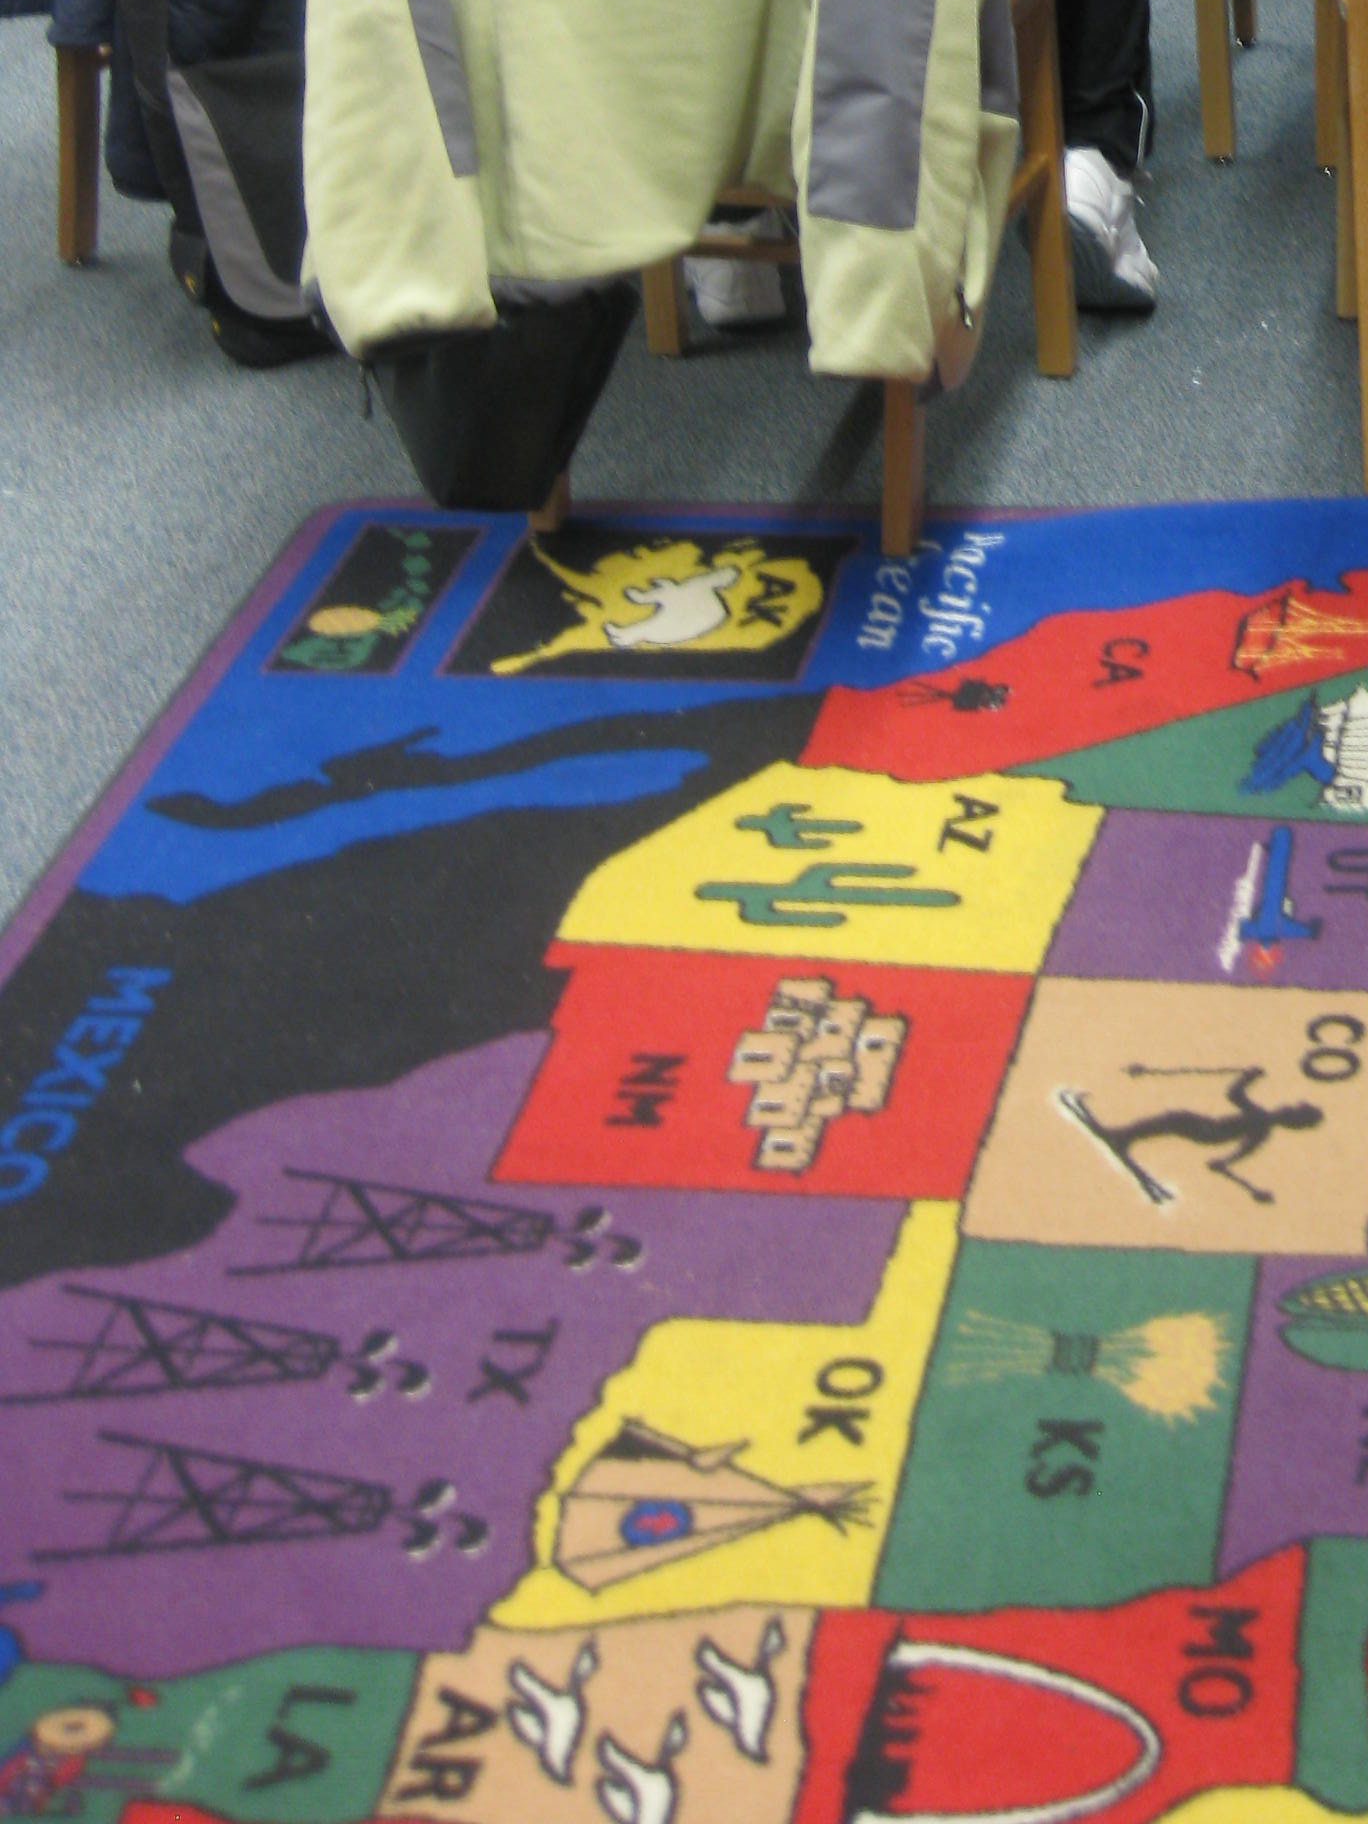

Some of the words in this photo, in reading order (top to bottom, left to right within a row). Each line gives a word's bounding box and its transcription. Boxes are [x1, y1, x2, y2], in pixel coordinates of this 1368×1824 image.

[746, 572, 797, 628] AK
[919, 531, 1005, 659] Pacific
[1092, 636, 1149, 688] CA
[937, 792, 1000, 854] AZ
[1300, 1012, 1367, 1083] CO
[606, 1053, 687, 1129] NM
[467, 1316, 560, 1405] TX
[798, 1356, 885, 1447] OK
[1024, 1417, 1105, 1501] KS
[1176, 1605, 1261, 1719] MO
[240, 1684, 357, 1790] LA
[393, 1685, 500, 1801] AR
